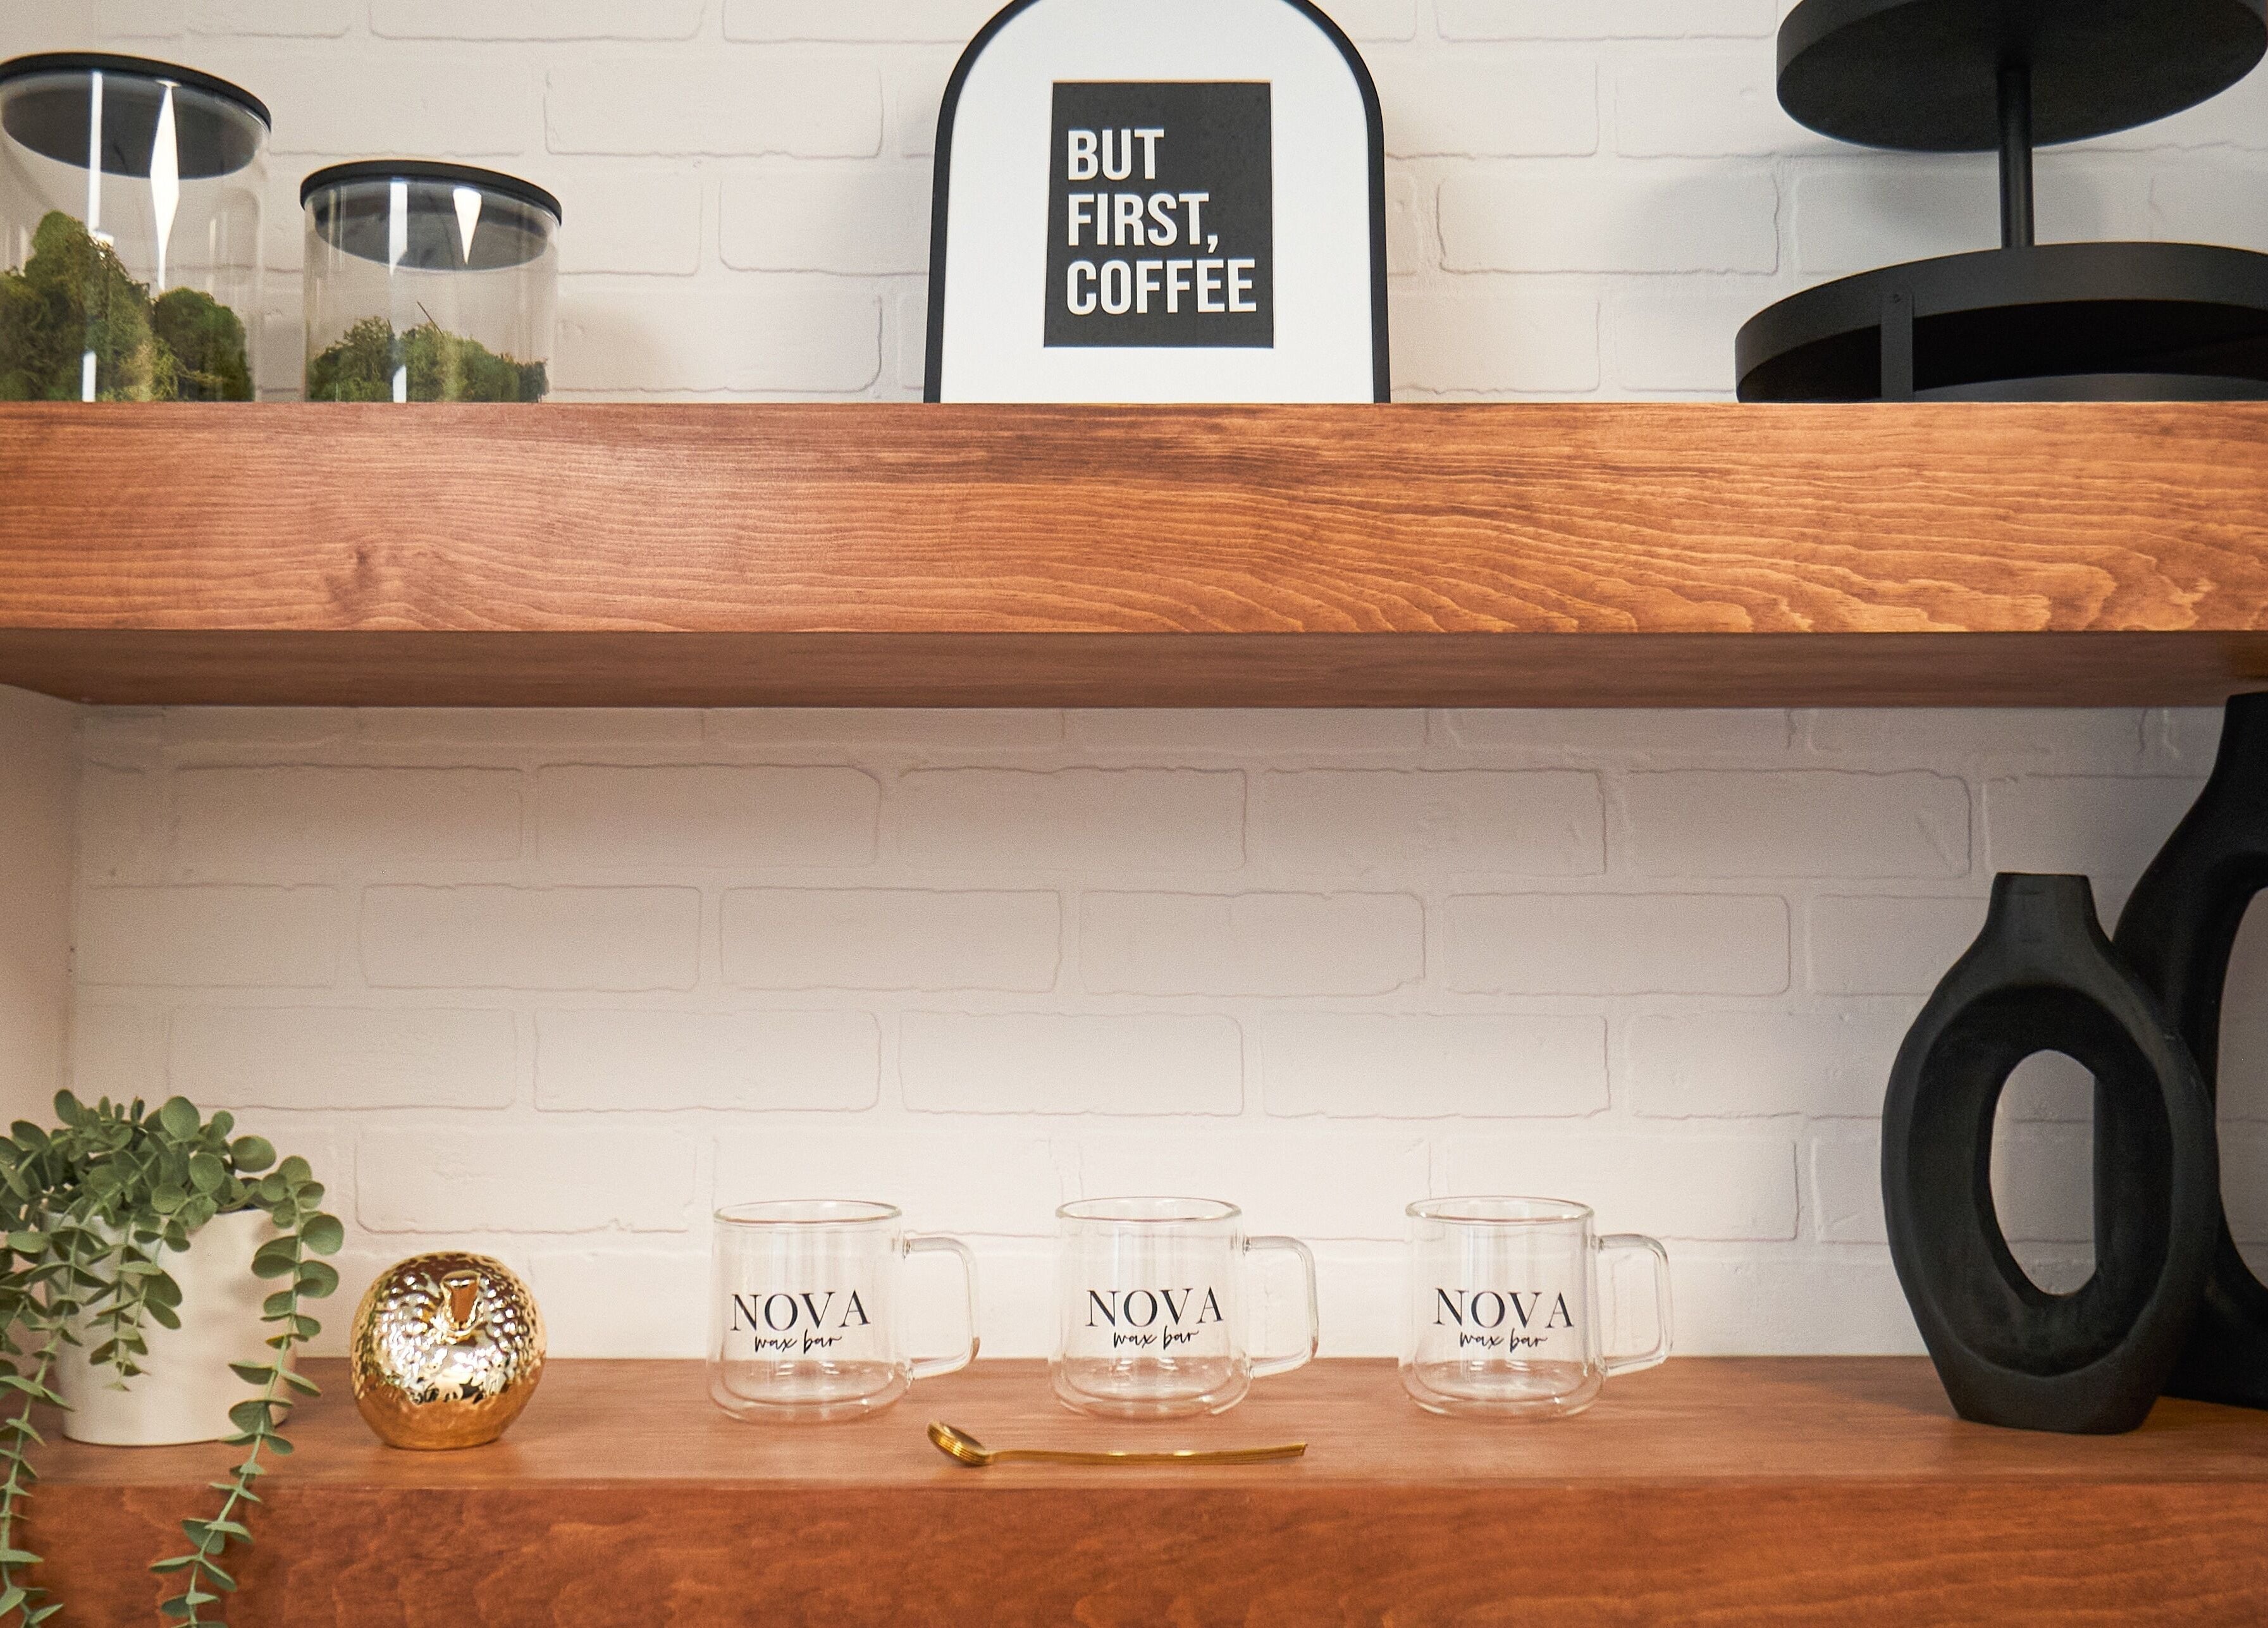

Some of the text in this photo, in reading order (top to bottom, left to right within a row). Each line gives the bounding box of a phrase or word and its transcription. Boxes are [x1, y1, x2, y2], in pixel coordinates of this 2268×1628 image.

[1068, 128, 1164, 180] BUT
[1068, 192, 1218, 254] FIRST,
[1067, 259, 1257, 315] COFFEE
[730, 1289, 871, 1331] NOVA
[1085, 1286, 1224, 1327] NOVA
[1433, 1288, 1574, 1328] NOVA
[755, 1329, 842, 1354] wax bar
[1113, 1325, 1199, 1350] wax bar
[1460, 1328, 1548, 1353] wax bar
